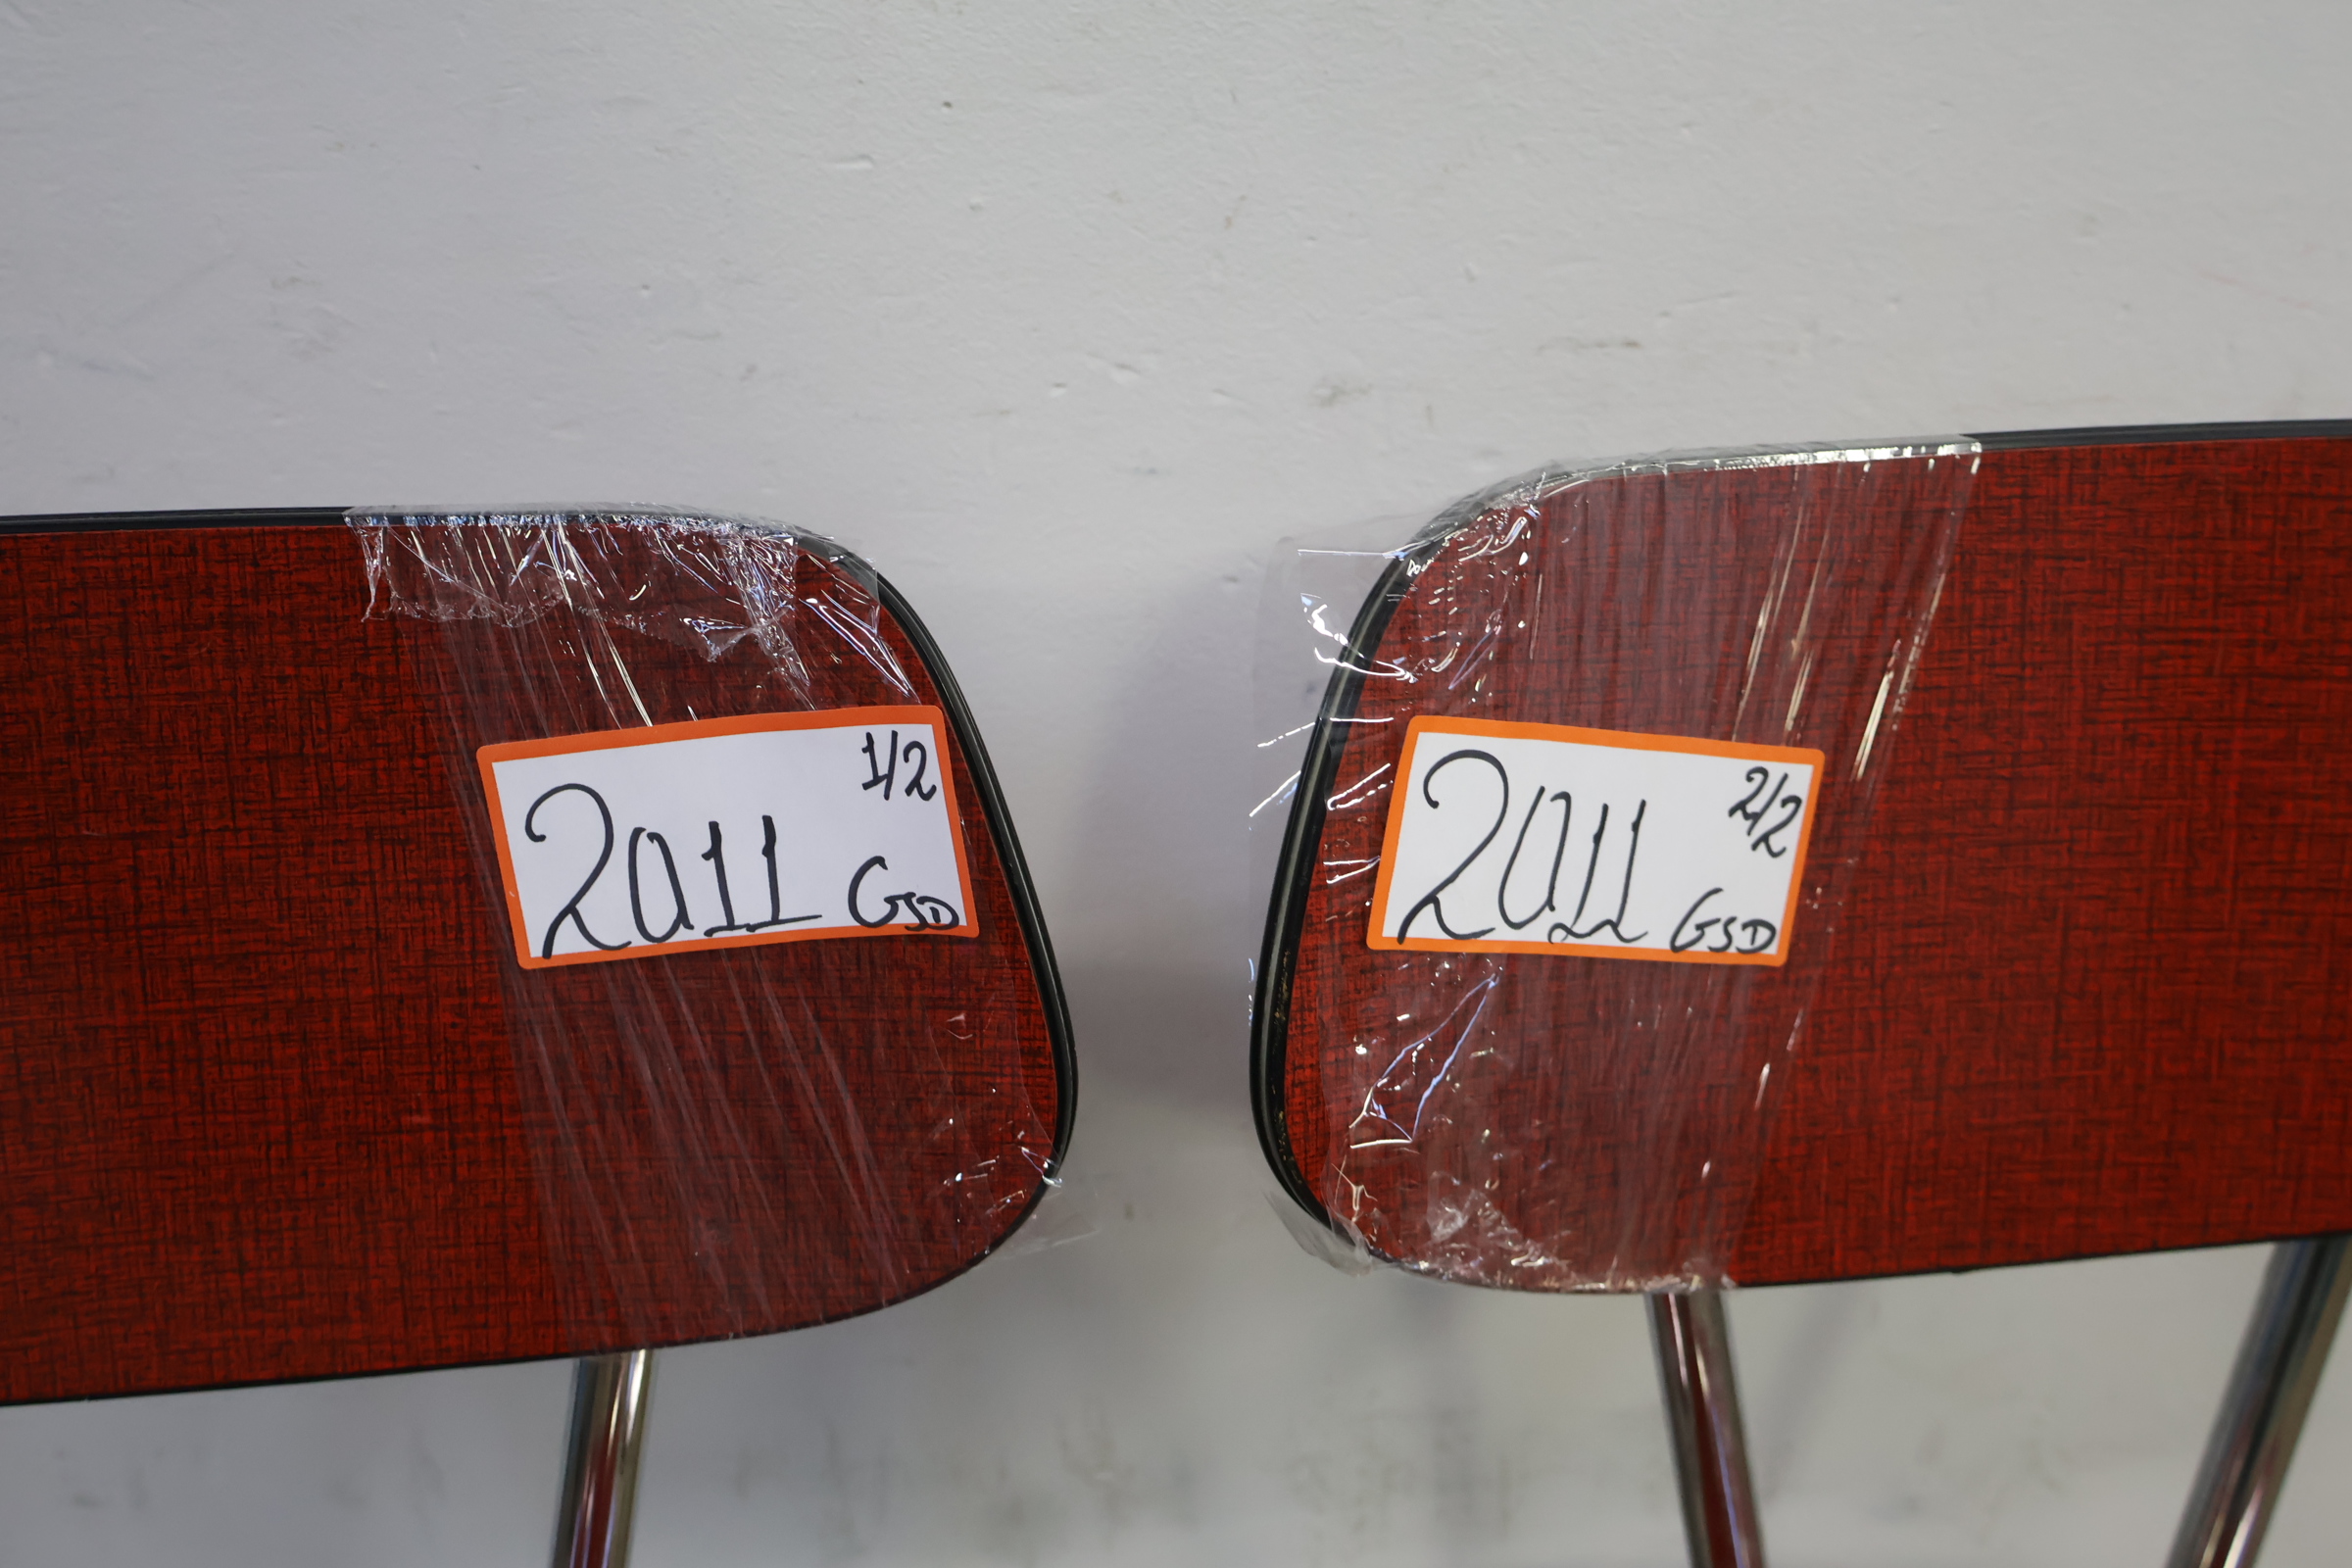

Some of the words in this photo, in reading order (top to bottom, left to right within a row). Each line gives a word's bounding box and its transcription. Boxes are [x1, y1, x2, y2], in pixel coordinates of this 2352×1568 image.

[861, 730, 937, 801] 1/2
[1397, 750, 1648, 946] 2011
[1729, 766, 1802, 858] 2/2
[524, 783, 822, 959] 2011
[848, 856, 960, 932] GSD
[1670, 887, 1777, 955] GSD
